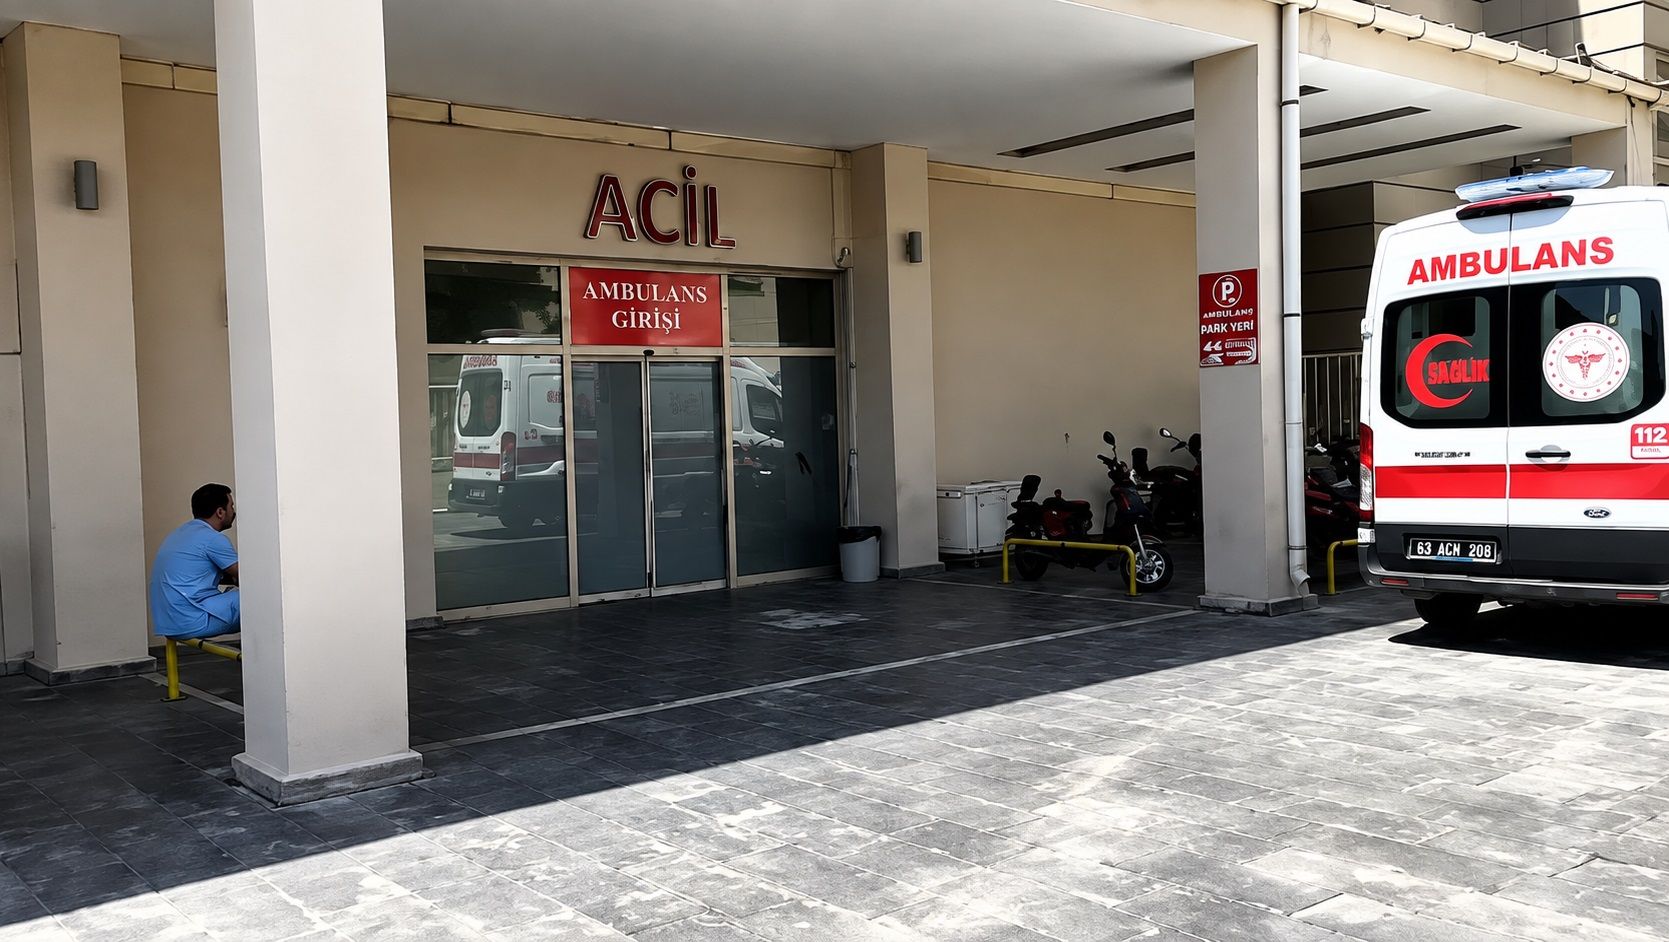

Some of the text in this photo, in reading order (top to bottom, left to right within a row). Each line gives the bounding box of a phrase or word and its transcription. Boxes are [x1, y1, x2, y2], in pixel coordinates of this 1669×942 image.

[583, 164, 737, 249] ACİL
[1406, 236, 1615, 285] AMBULANS
[582, 281, 708, 304] AMBULANS
[611, 306, 681, 334] GİRİŞİ
[1201, 320, 1254, 335] PARK YERİ
[1634, 426, 1668, 444] 112
[1417, 541, 1432, 555] 63
[1468, 543, 1492, 558] 208
